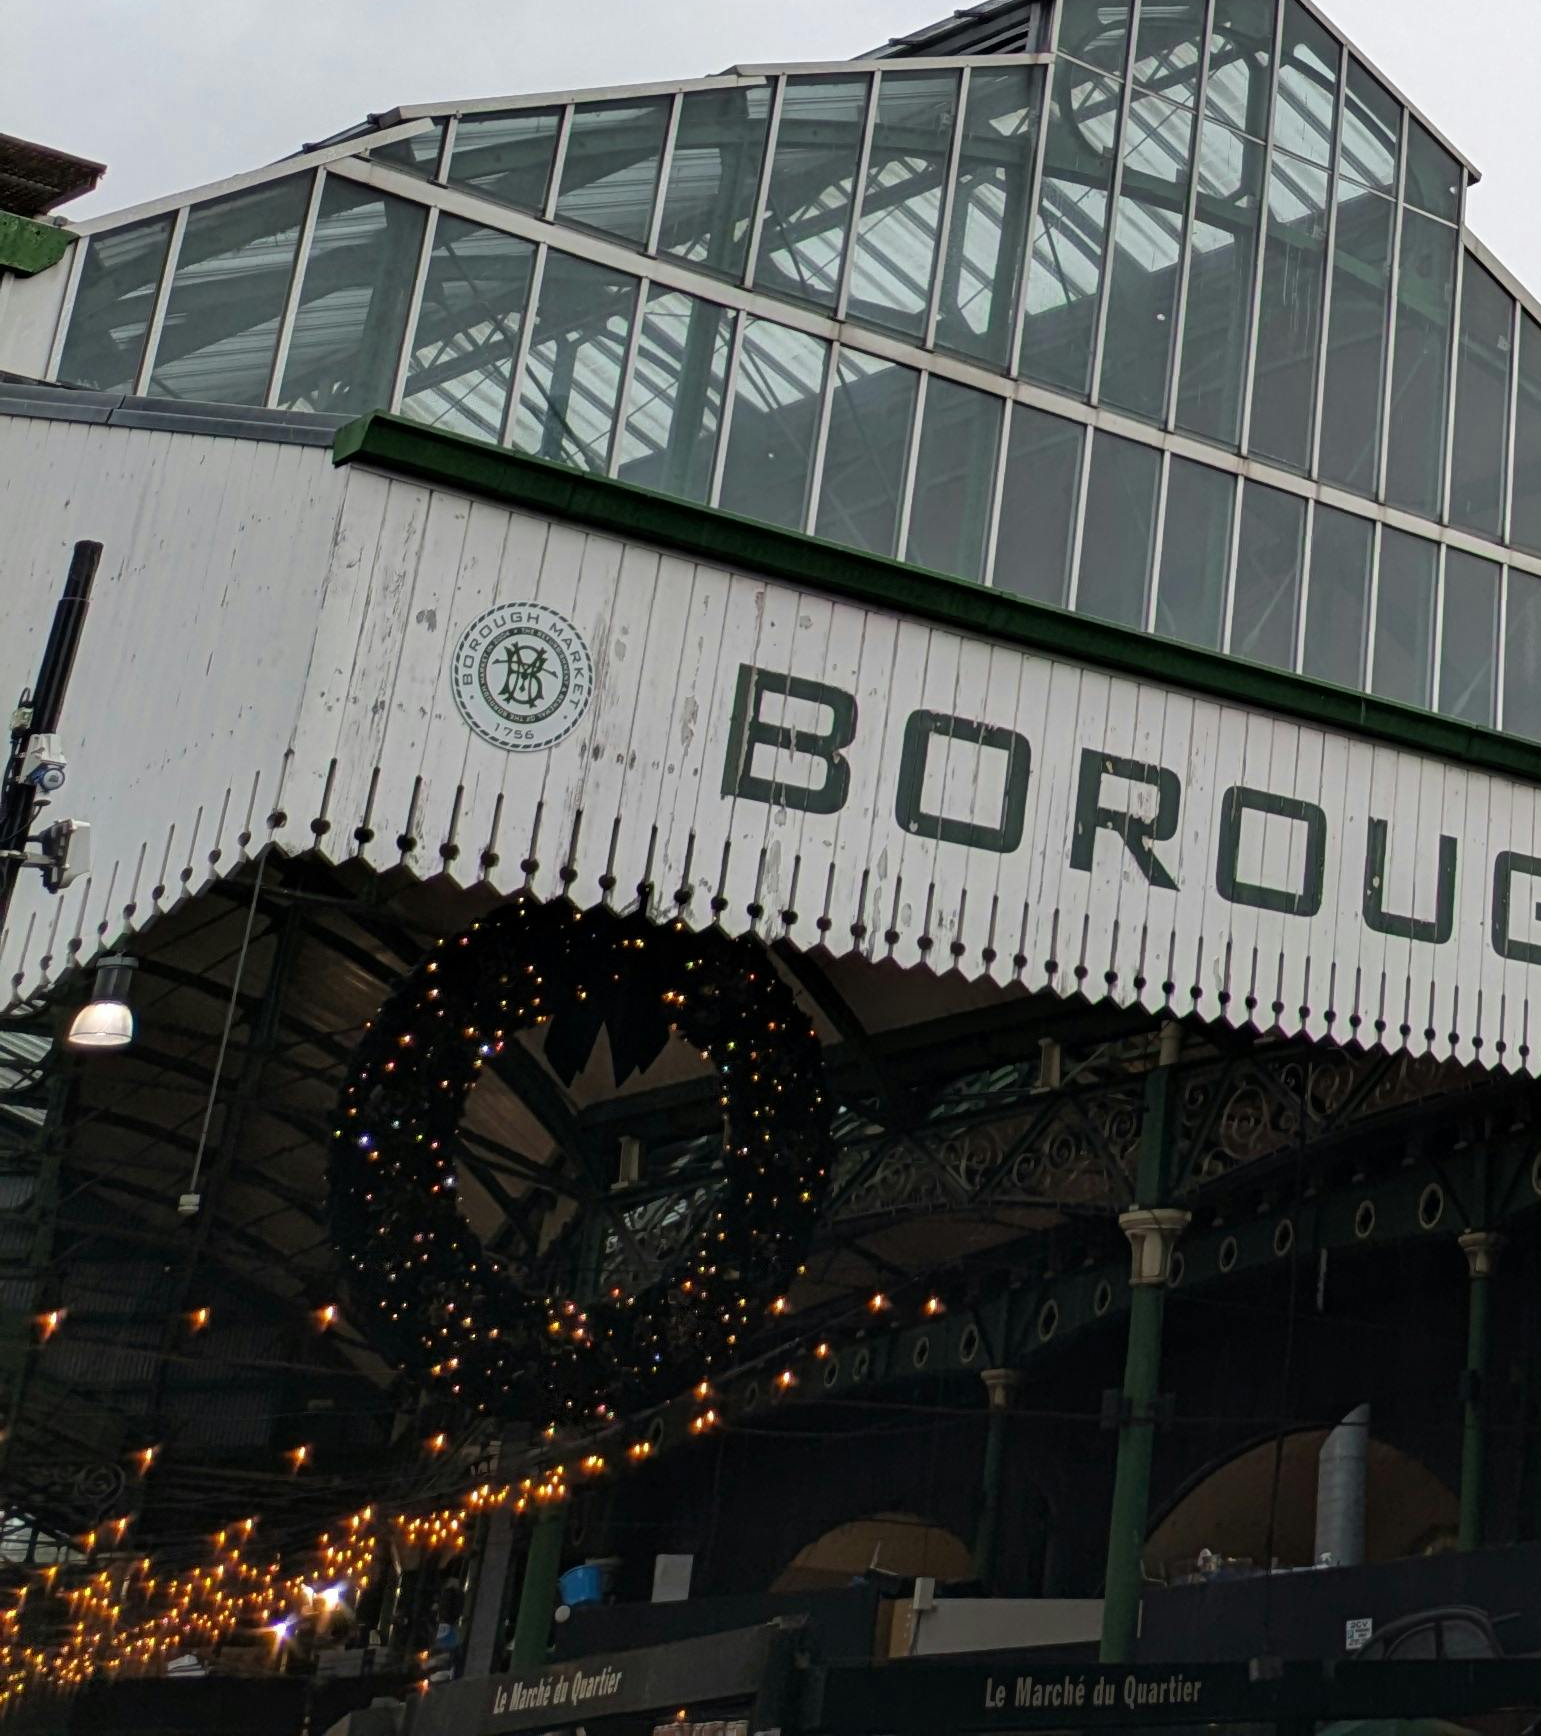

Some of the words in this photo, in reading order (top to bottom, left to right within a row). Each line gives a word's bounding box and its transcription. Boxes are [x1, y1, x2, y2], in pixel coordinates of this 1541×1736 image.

[462, 611, 540, 686] BOROUGH
[549, 622, 585, 711] MARKET
[494, 722, 535, 740] 1756
[493, 1685, 508, 1714] Le
[508, 1676, 553, 1712] Marché
[553, 1674, 569, 1704] du
[571, 1665, 622, 1706] Quartier
[984, 1677, 1006, 1707] Le
[1014, 1674, 1085, 1707] Marché
[1092, 1675, 1116, 1705] du
[1123, 1673, 1202, 1710] Quartier
